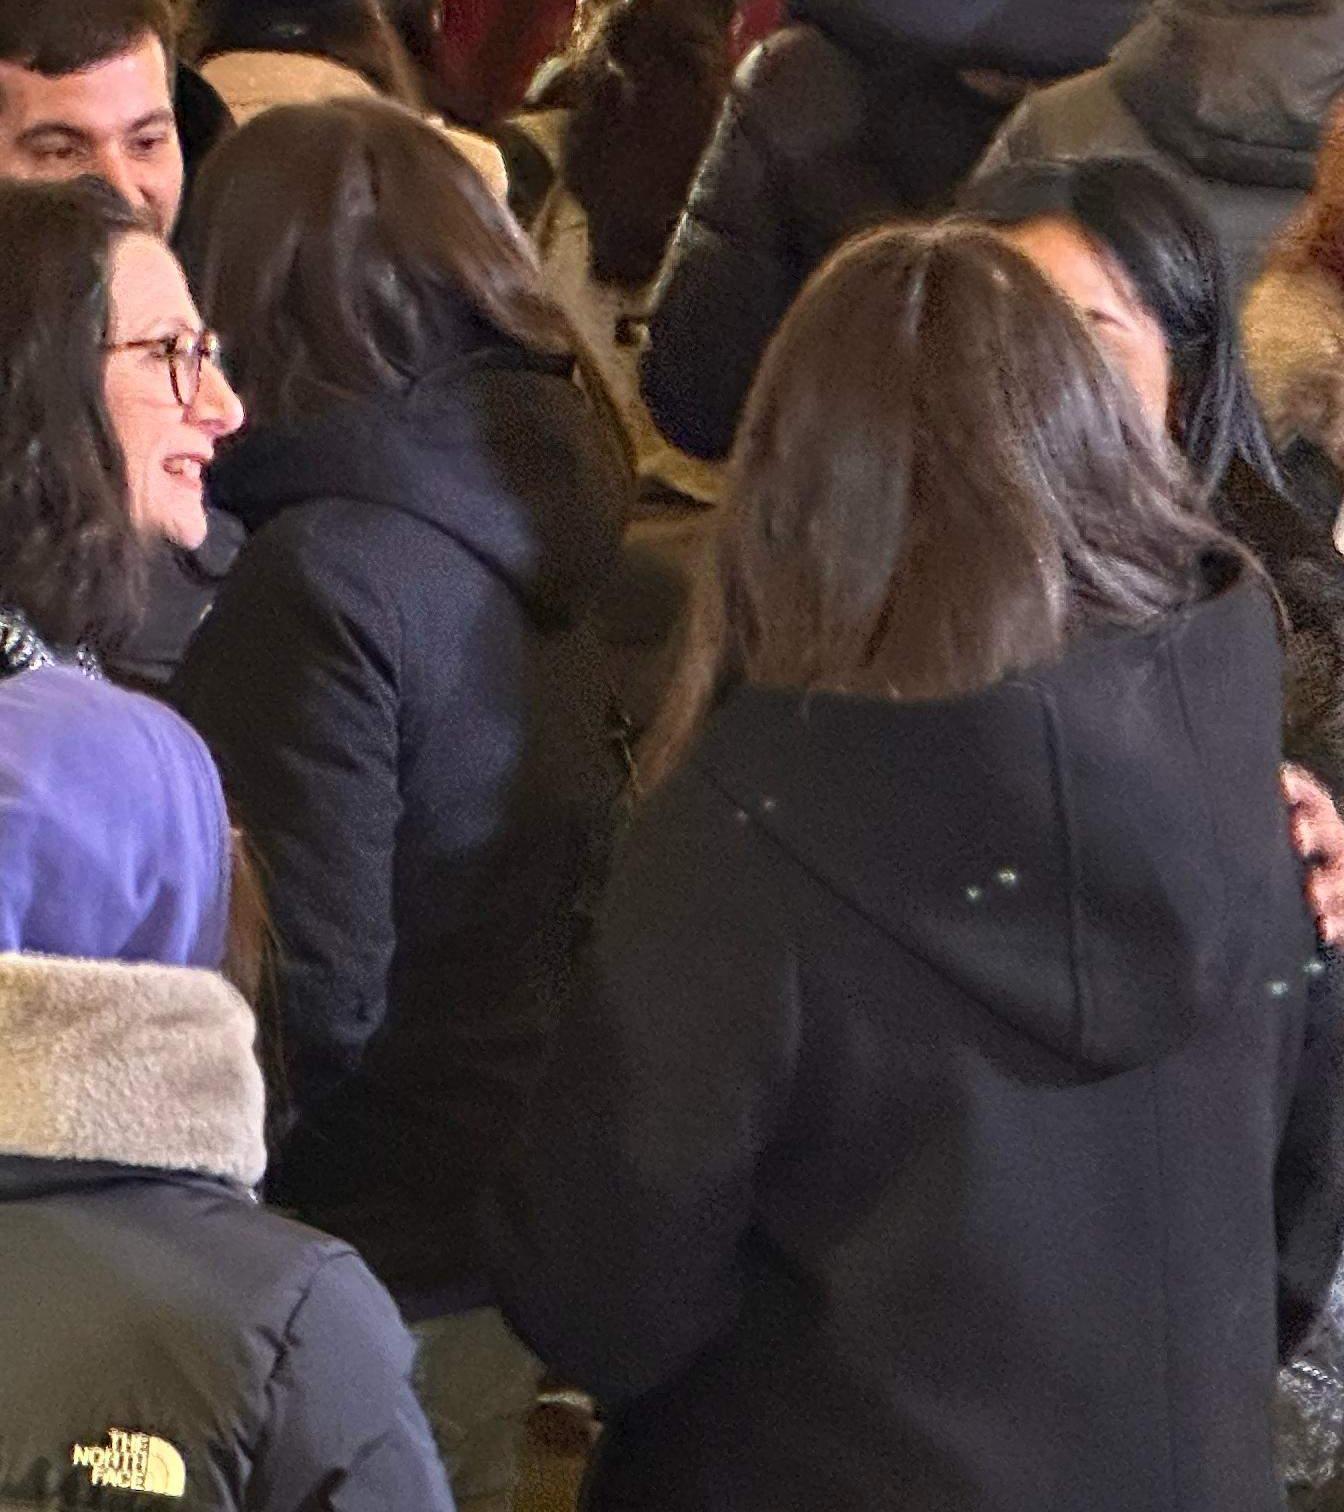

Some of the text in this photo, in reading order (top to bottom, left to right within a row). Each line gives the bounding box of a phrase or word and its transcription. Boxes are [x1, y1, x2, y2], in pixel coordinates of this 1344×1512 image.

[108, 1427, 149, 1453] THE
[72, 1443, 148, 1472] NORTH
[91, 1464, 147, 1491] FACE
